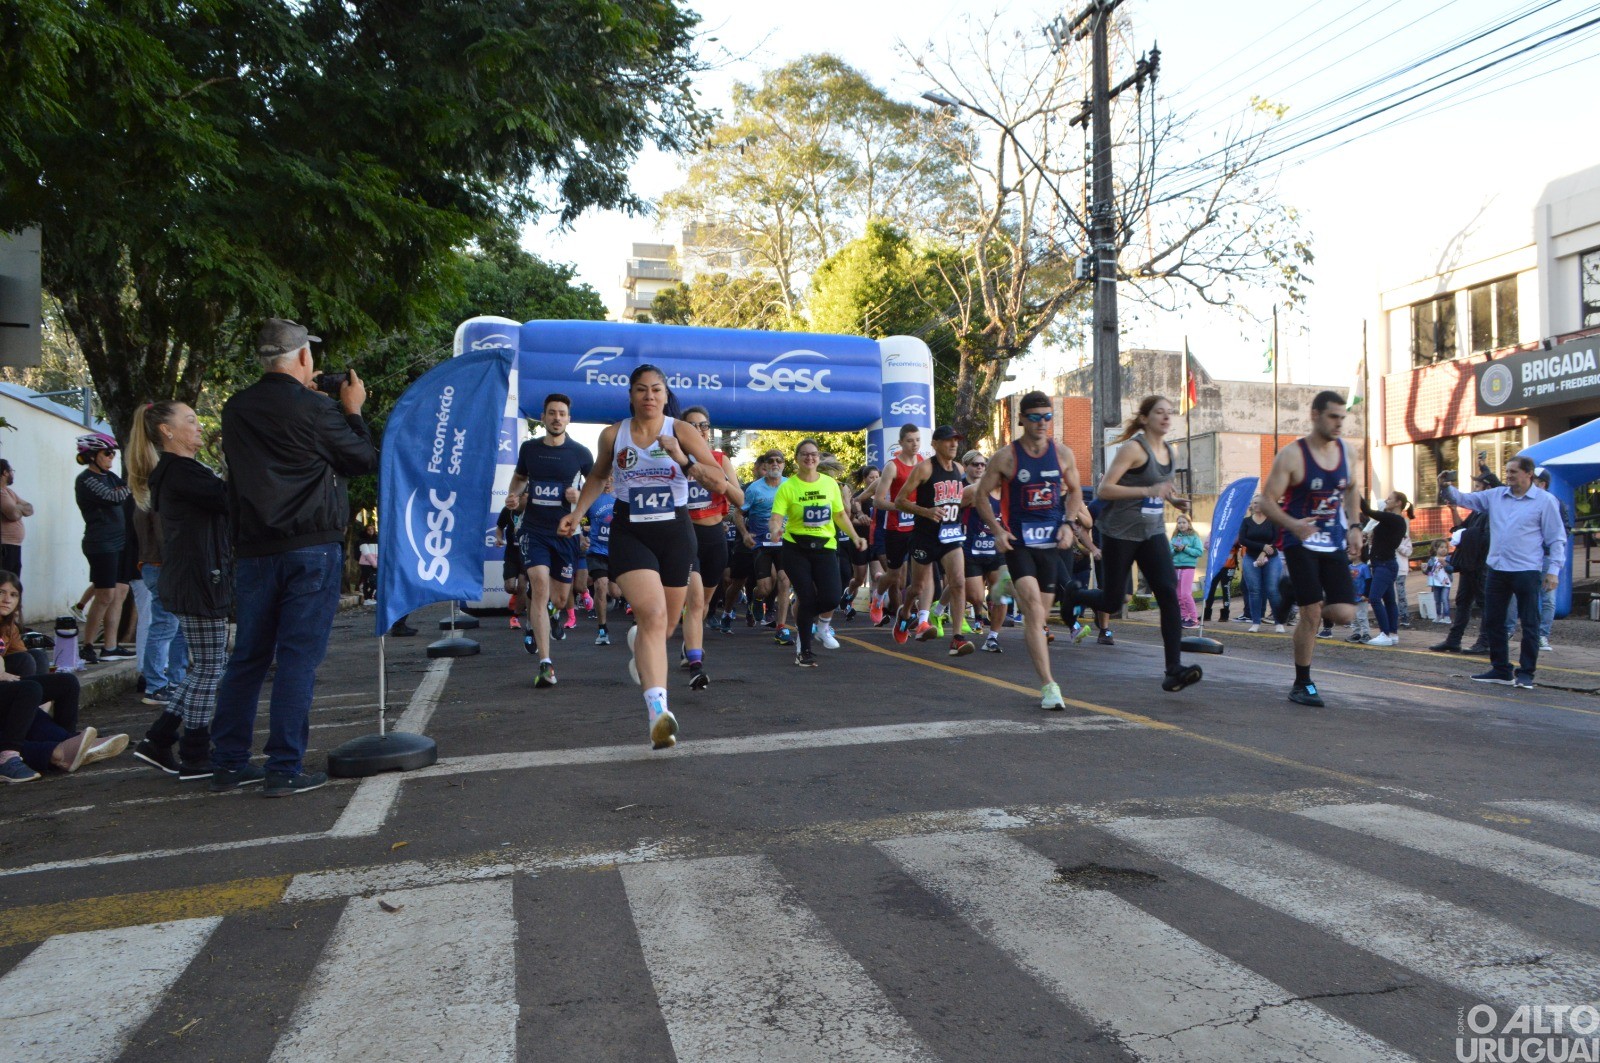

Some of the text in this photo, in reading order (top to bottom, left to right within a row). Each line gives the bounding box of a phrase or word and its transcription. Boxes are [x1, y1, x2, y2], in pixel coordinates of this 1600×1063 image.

[747, 355, 831, 393] Sesc
[1521, 349, 1597, 383] BRIGADA
[586, 369, 722, 391] Fecocio RS
[1537, 382, 1555, 395] BPM
[890, 398, 927, 415] Sesc
[428, 385, 455, 473] Fecomércio
[447, 428, 467, 476] Senac
[535, 485, 559, 497] 044
[1027, 488, 1053, 502] TAG
[634, 492, 671, 508] 147
[806, 509, 830, 519] 012
[942, 505, 959, 522] 30
[412, 488, 457, 586] Sesc
[941, 528, 961, 537] 056
[1026, 526, 1054, 540] 107
[1305, 531, 1331, 543] 05
[975, 540, 995, 548] 059
